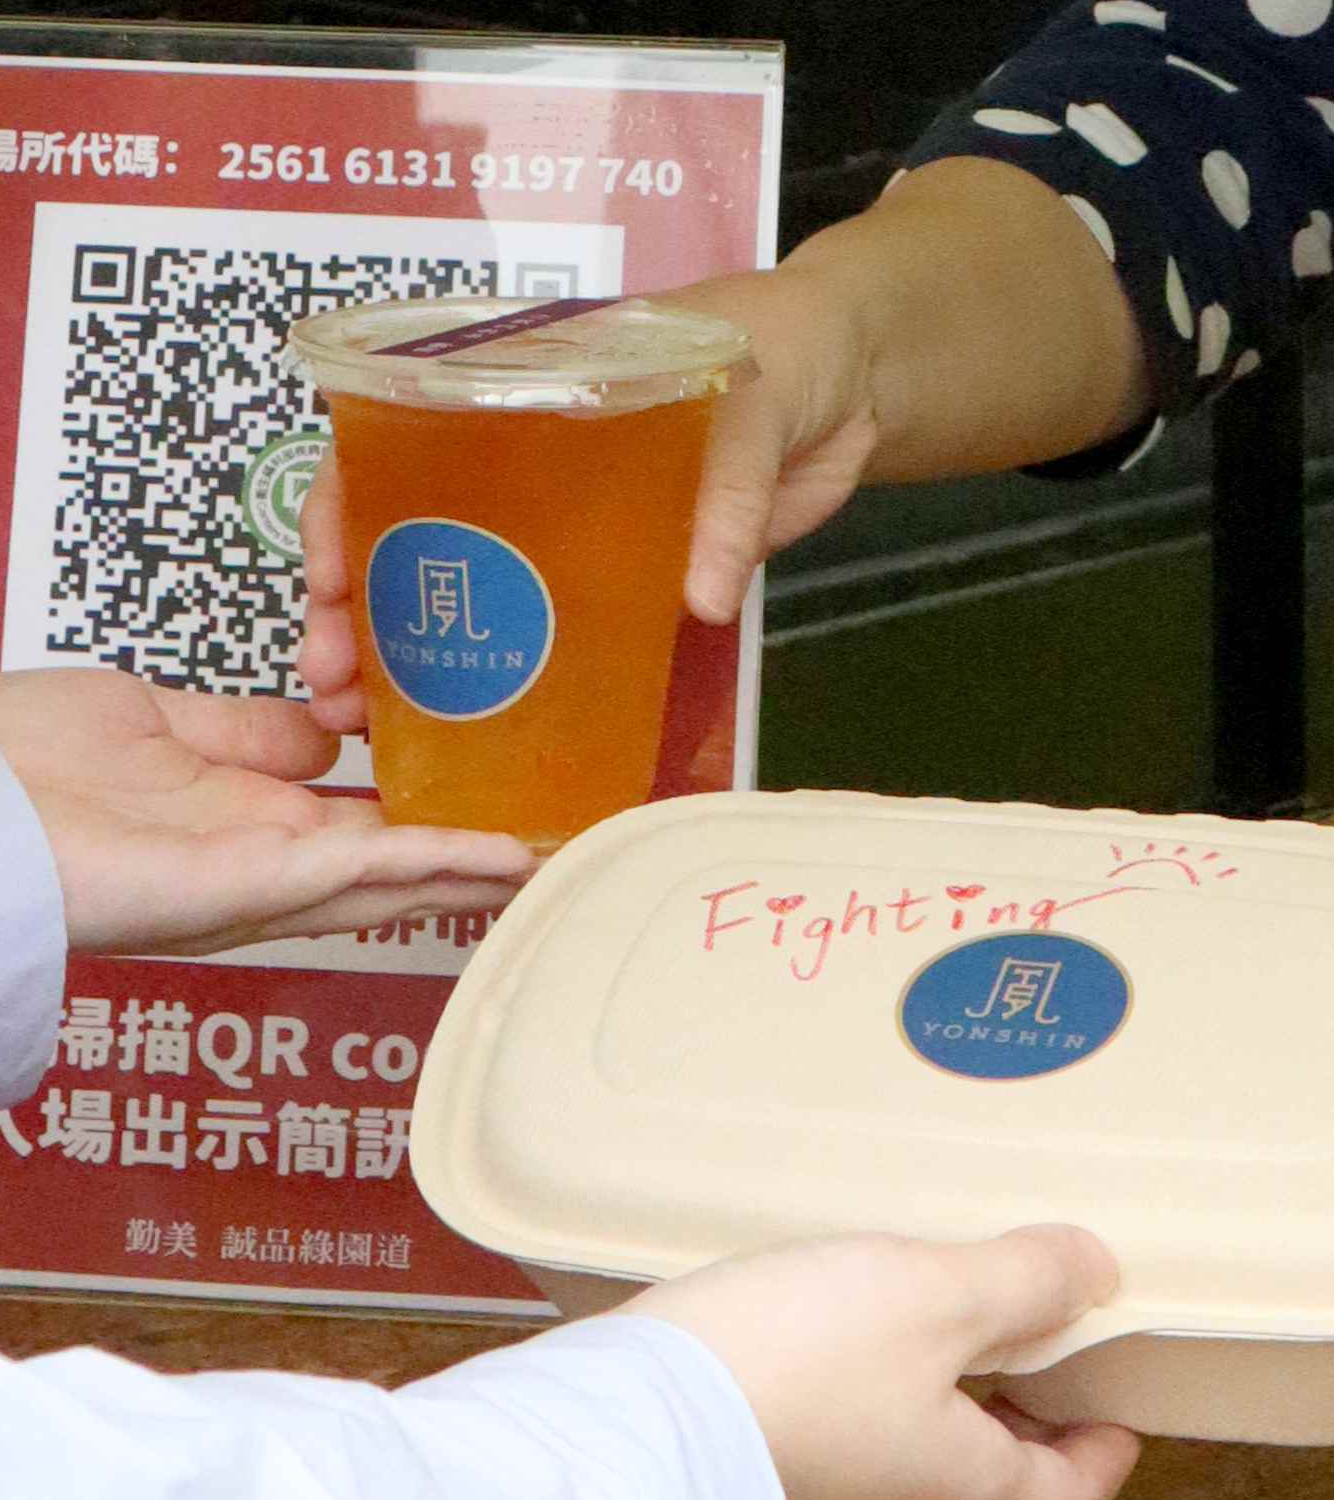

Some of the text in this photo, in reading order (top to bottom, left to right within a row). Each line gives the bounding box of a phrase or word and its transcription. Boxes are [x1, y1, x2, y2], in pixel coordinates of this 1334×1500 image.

[218, 141, 330, 184] 2561
[344, 146, 456, 189] 6131
[470, 151, 584, 193] 9197
[600, 155, 684, 198] 740
[386, 639, 525, 670] YONSHIN
[700, 879, 1163, 982] Fighting
[331, 1032, 426, 1083] co
[922, 1020, 1087, 1051] YONSHIN
[125, 1217, 413, 1269] 勤美 誠品綠園道
